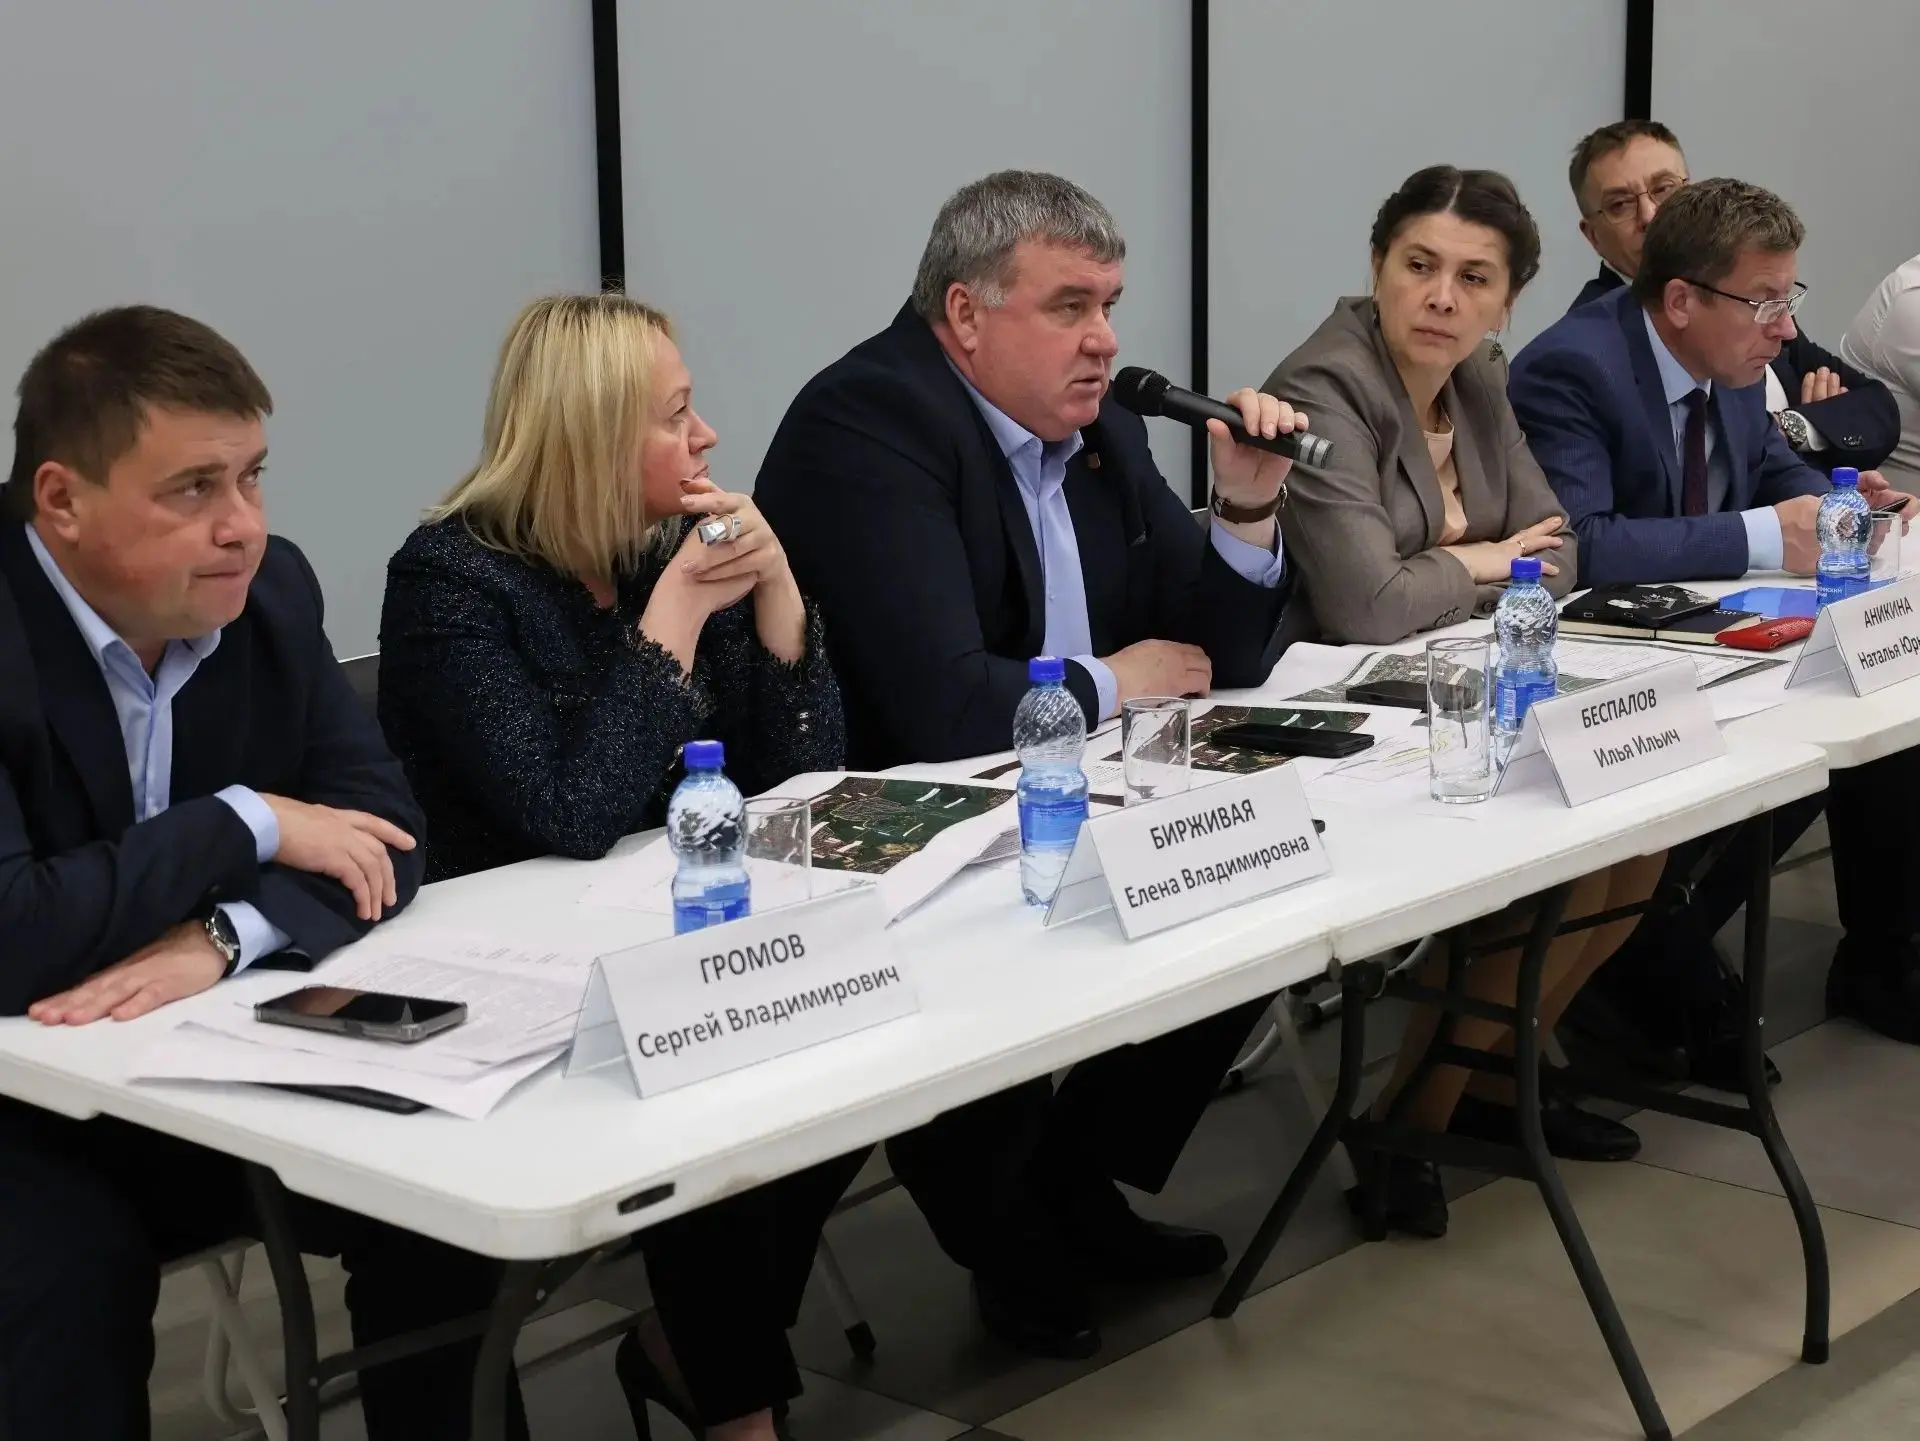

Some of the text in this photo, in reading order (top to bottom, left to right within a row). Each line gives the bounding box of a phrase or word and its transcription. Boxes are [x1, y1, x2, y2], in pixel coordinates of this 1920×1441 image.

[1864, 596, 1913, 629] АНИКИНА
[1857, 643, 1901, 670] Наталья
[1581, 688, 1657, 729] БЕСПАЛОВ
[1593, 728, 1681, 768] Илья Ильич
[1149, 798, 1256, 850] БИРЖИВАЯ
[1125, 835, 1310, 909] Елена Владимировна
[700, 933, 806, 984] ГРОМОВ
[638, 966, 900, 1058] Сергей Владимирович
